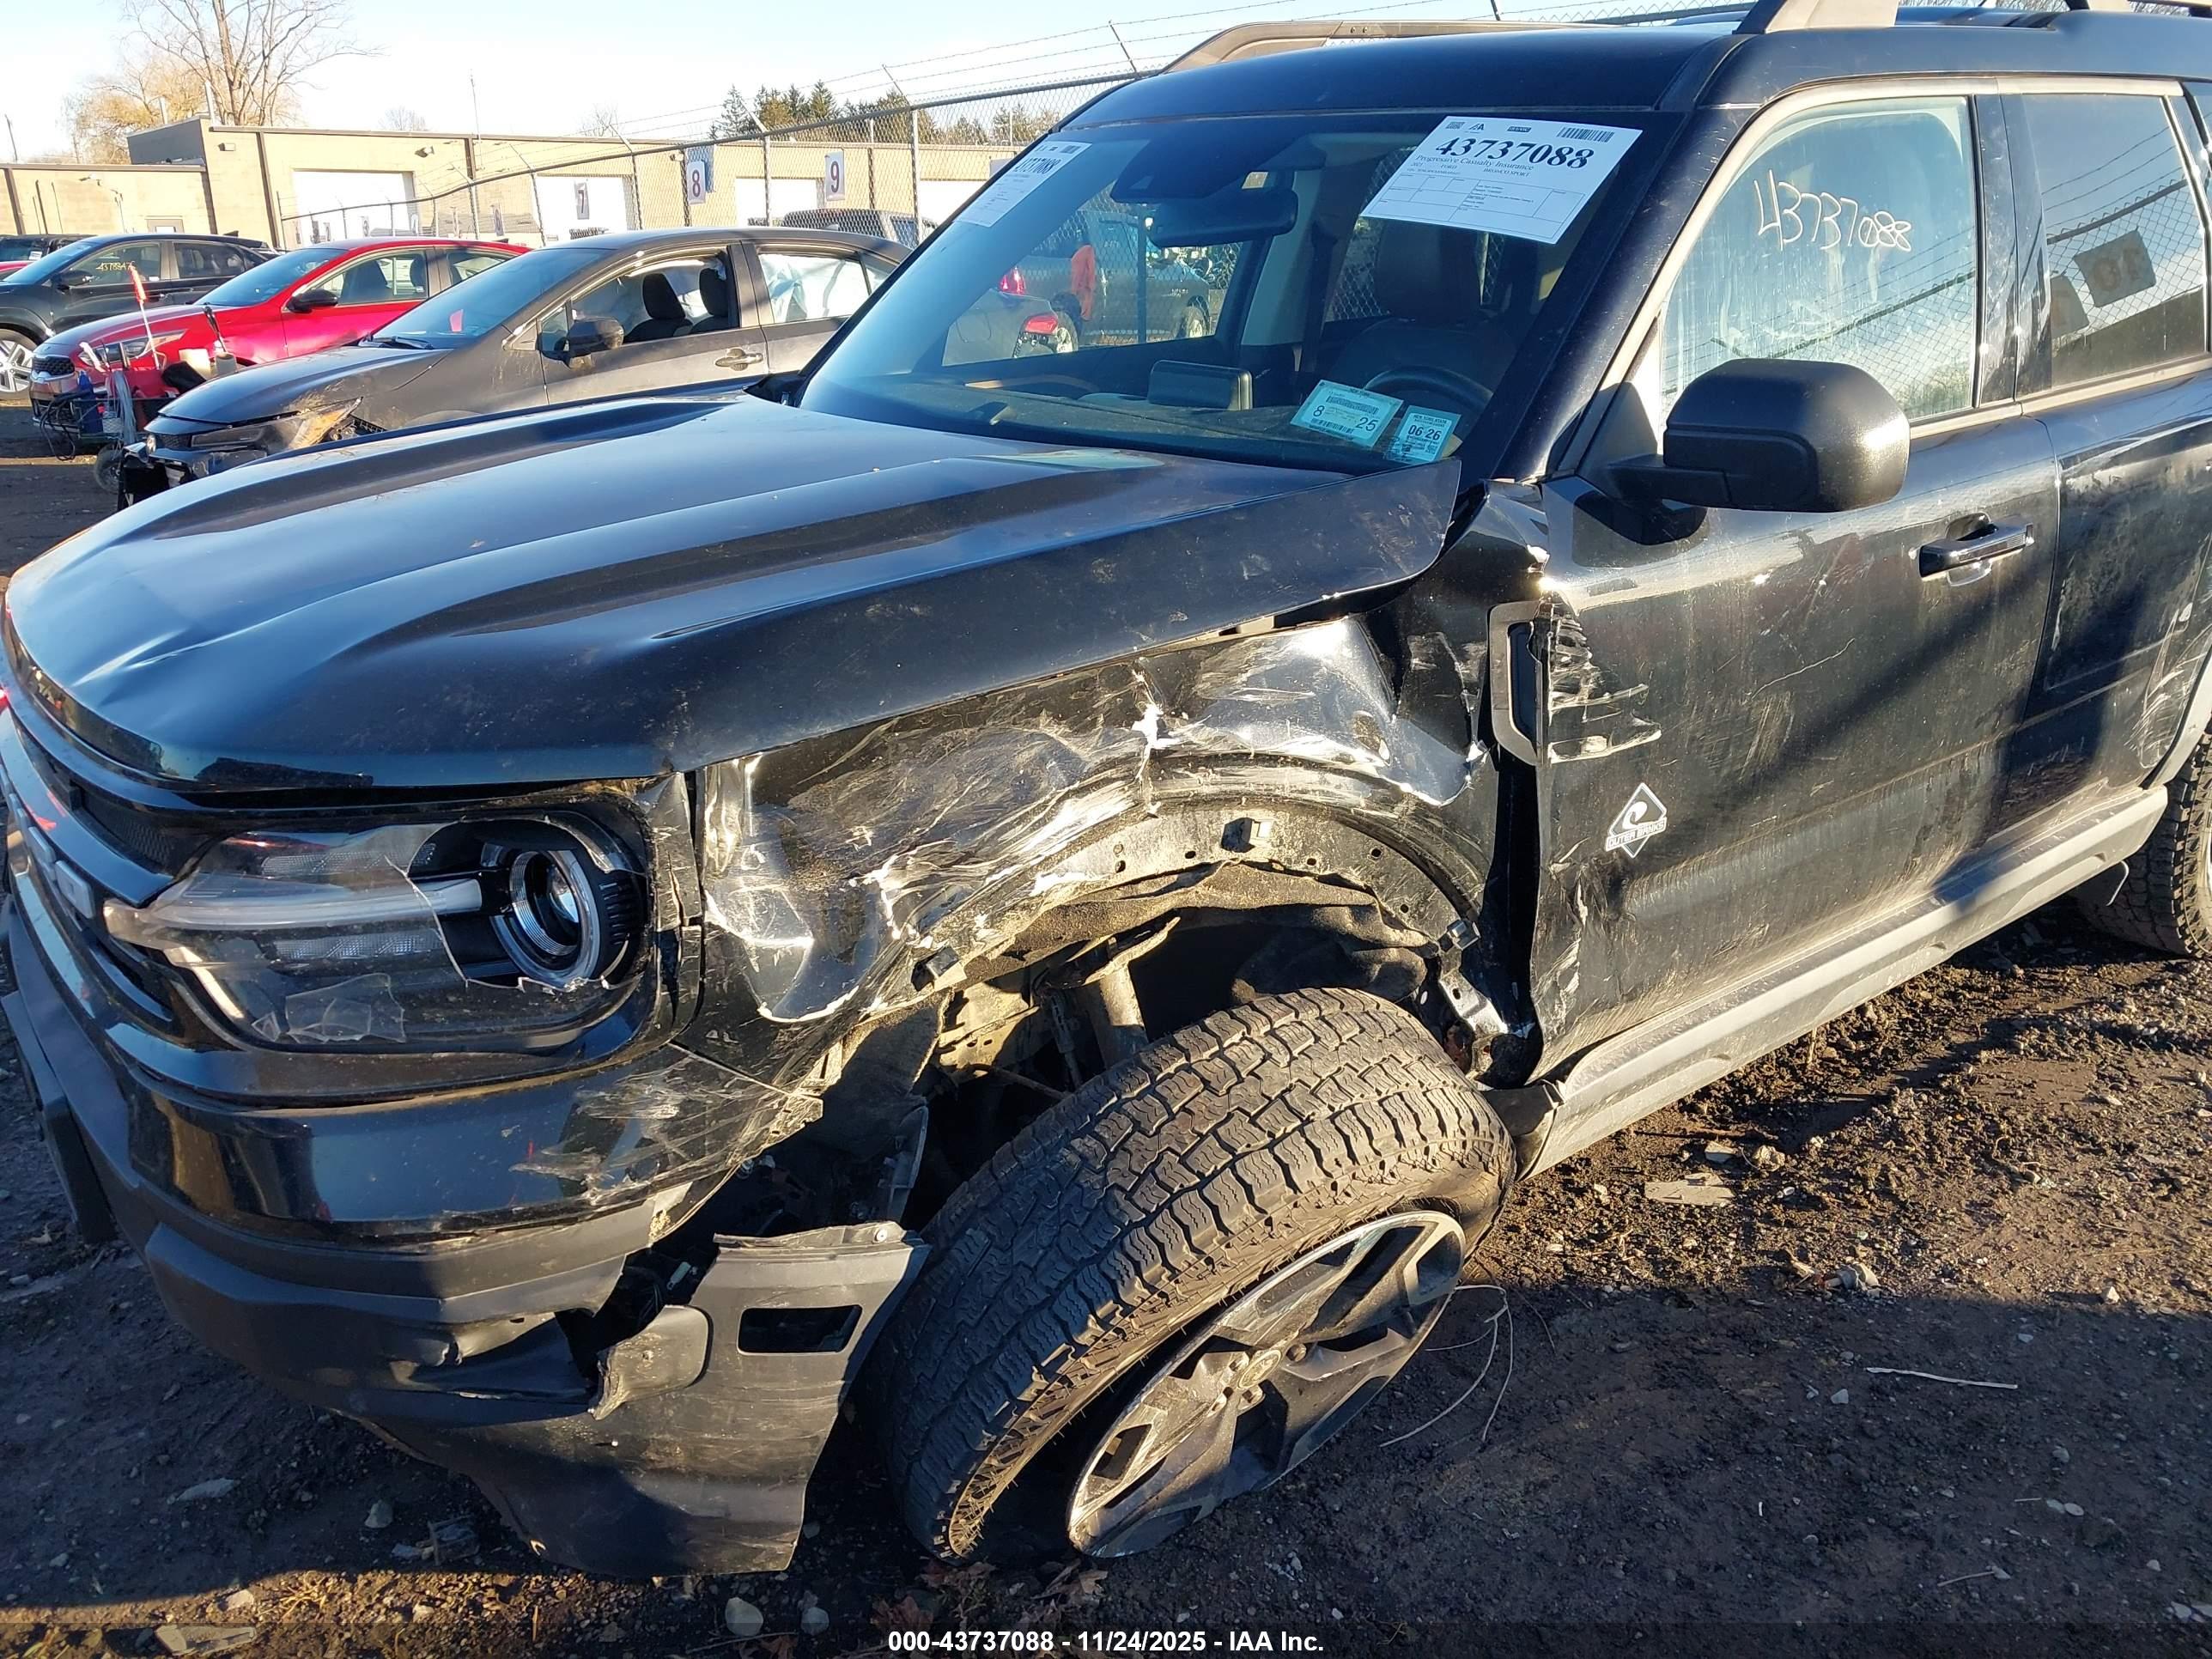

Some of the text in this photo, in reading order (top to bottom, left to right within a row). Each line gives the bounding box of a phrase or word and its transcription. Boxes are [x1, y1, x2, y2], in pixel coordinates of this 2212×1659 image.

[1416, 155, 1534, 171] Progressive Casualty Insurance
[1436, 137, 1594, 169] 43737088
[691, 169, 702, 198] 8
[830, 161, 840, 193] 9
[577, 189, 585, 214] 7
[1754, 169, 1911, 252] 43737088
[1312, 404, 1325, 417] 8
[1355, 416, 1379, 432] 25
[1407, 424, 1424, 436] 06
[1425, 428, 1443, 441] 26
[1608, 822, 1664, 847] OUTER BANKS
